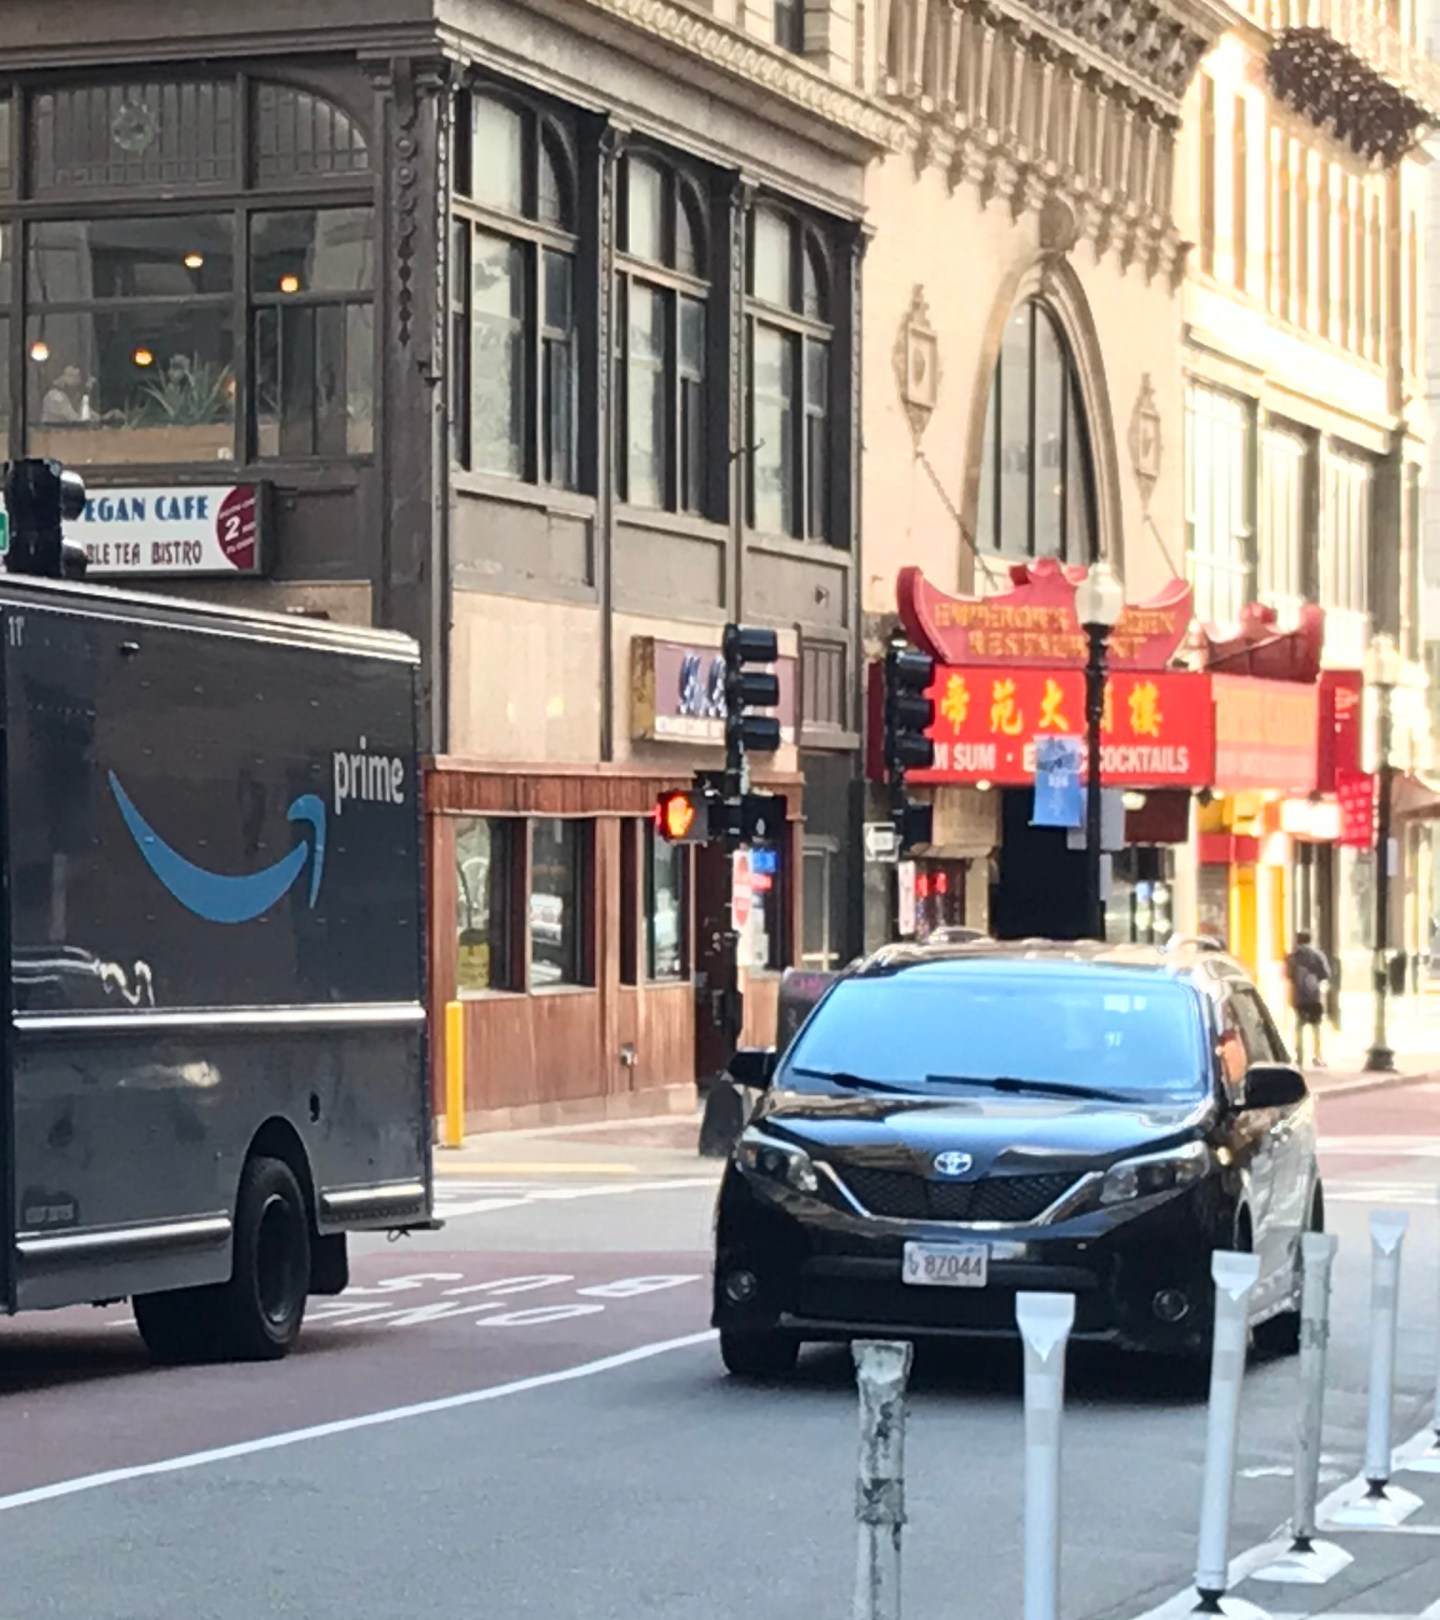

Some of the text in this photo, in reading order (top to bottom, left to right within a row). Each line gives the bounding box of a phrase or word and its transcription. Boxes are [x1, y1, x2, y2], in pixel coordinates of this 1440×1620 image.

[84, 496, 146, 522] EGAN
[155, 495, 208, 521] CAFE
[115, 542, 141, 565] TEA
[151, 540, 203, 565] BISTRO
[953, 742, 996, 772] SUM
[333, 734, 405, 816] prime
[302, 1302, 605, 1327] ONL
